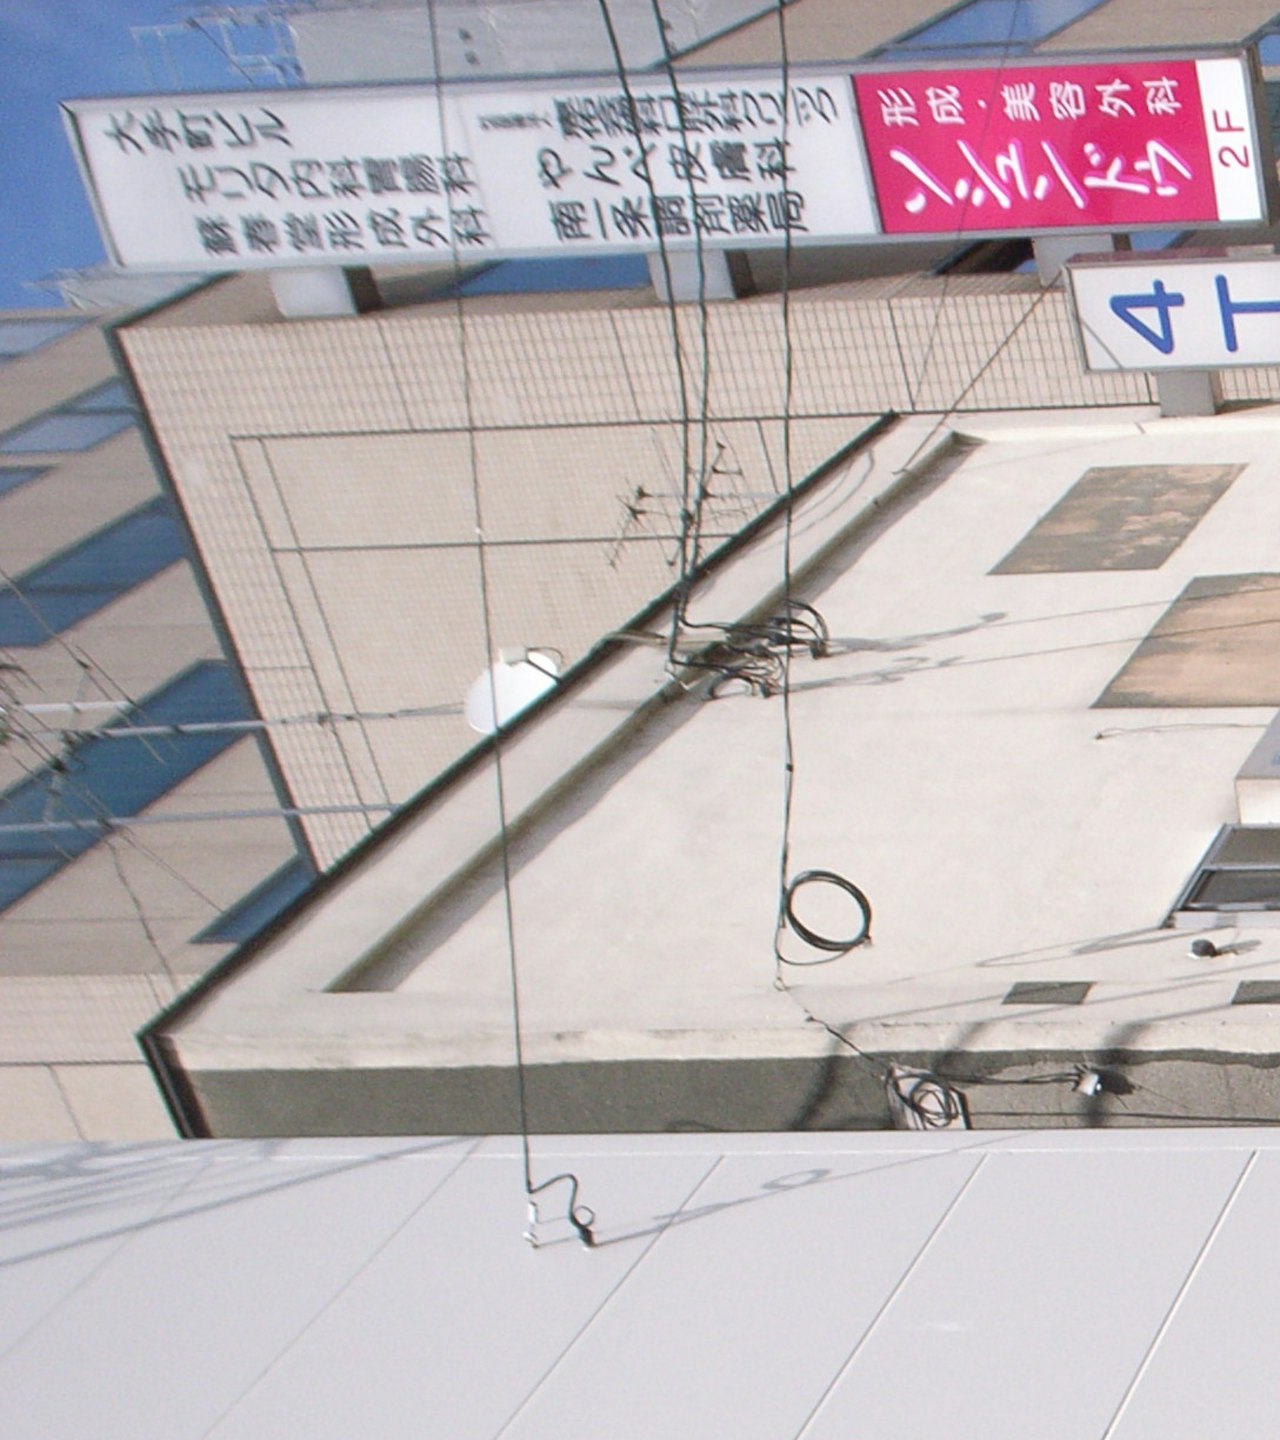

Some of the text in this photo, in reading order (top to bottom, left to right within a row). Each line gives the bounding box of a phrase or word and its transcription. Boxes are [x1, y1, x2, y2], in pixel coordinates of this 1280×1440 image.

[102, 107, 295, 154] 大手町ビル
[1212, 108, 1250, 169] 2F
[176, 154, 478, 201] モリタ内科胃腸科
[535, 137, 797, 190] やんべ皮膚科
[889, 139, 1194, 213] ソシュンドウ
[195, 206, 491, 255] 蘇春堂形成外科
[549, 190, 808, 242] 南一条調剤薬局
